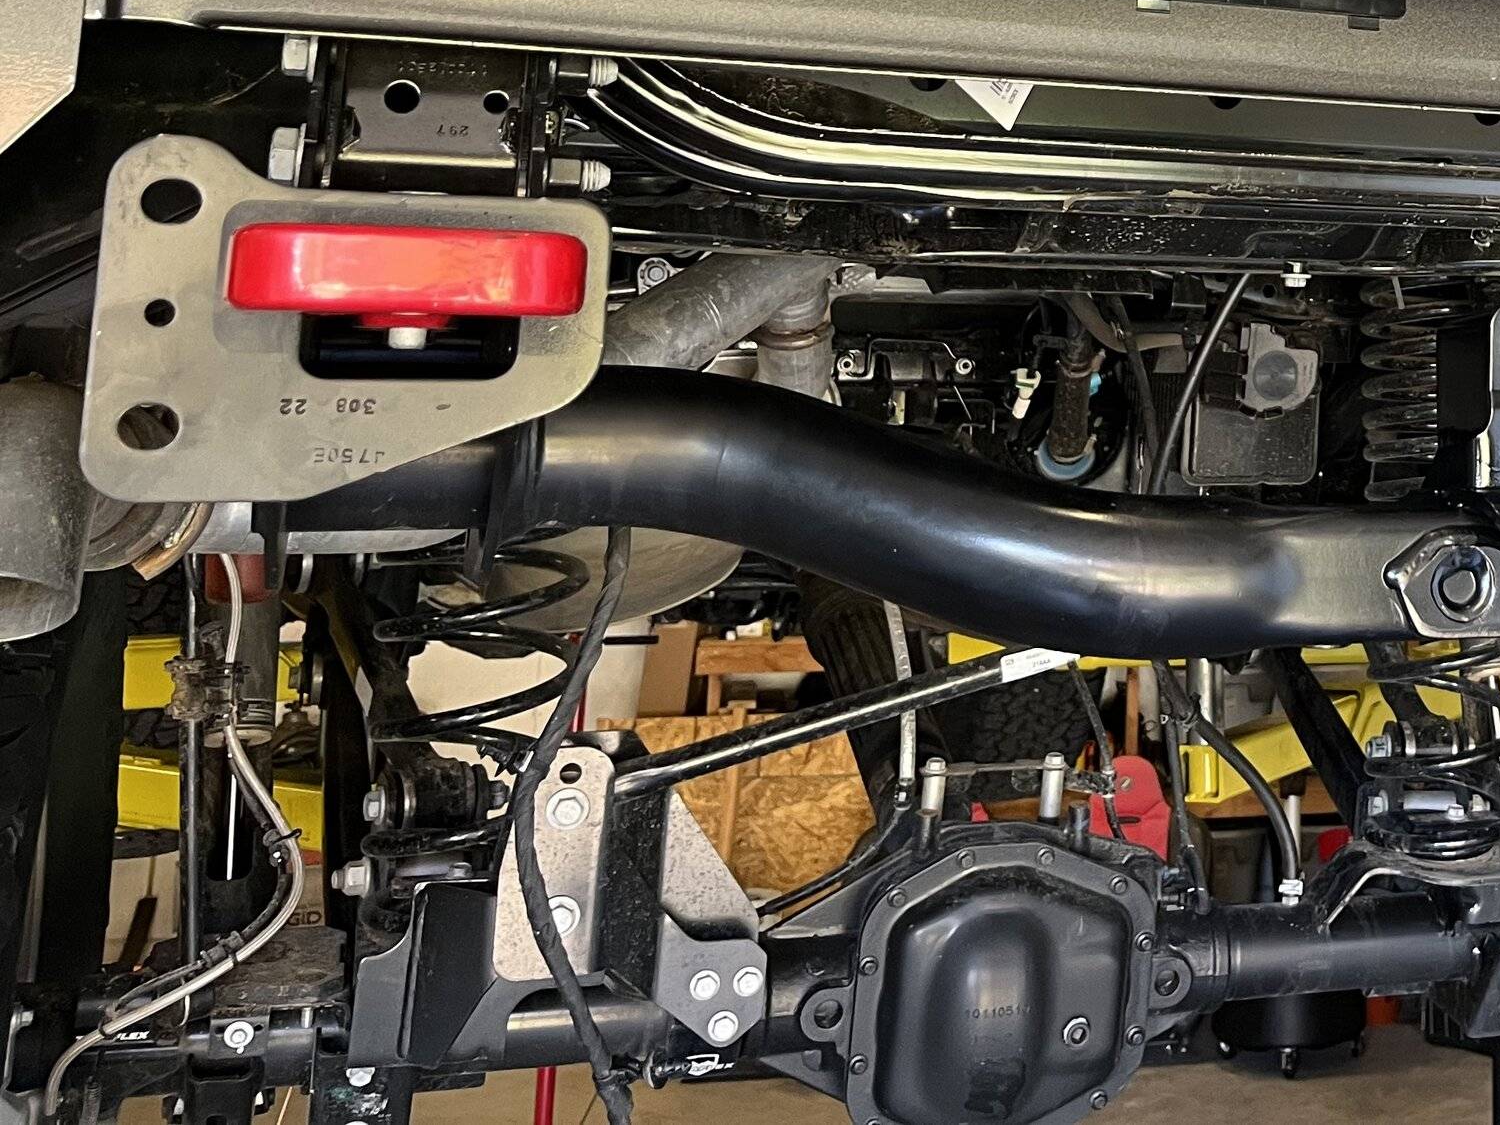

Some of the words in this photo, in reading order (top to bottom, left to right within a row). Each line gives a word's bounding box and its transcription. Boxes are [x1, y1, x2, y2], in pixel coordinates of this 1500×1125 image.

[435, 124, 469, 138] 297
[279, 398, 308, 415] 22
[335, 398, 377, 415] 308
[288, 910, 322, 926] GID
